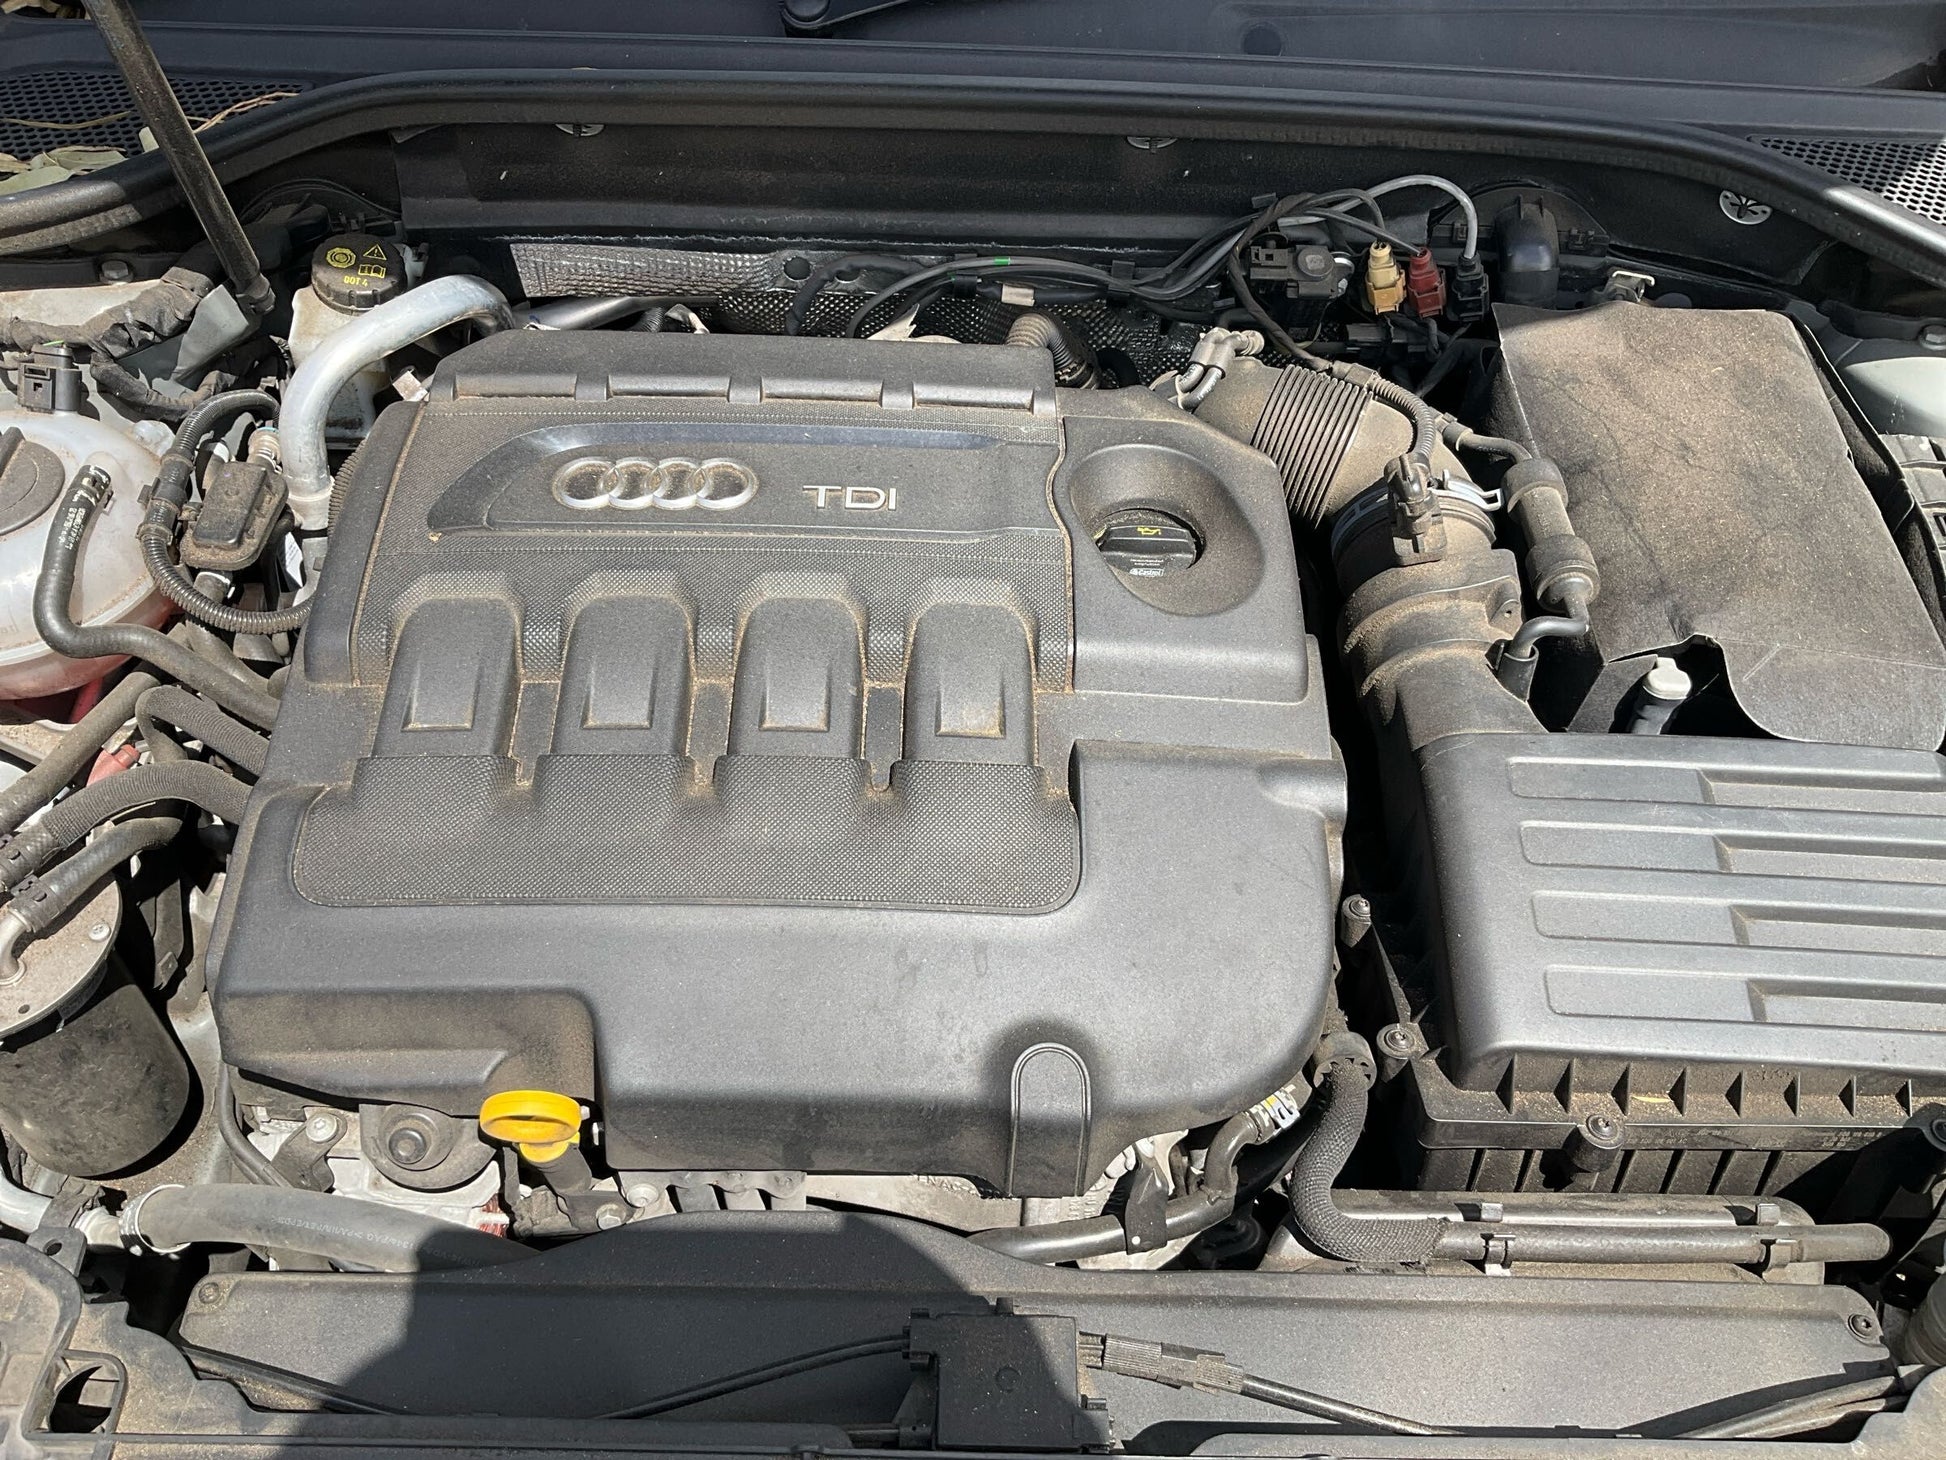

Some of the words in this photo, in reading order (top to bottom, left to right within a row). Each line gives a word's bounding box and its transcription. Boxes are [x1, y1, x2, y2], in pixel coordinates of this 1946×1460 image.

[343, 275, 361, 286] DOT
[361, 278, 369, 287] 4
[802, 485, 897, 511] TDI
